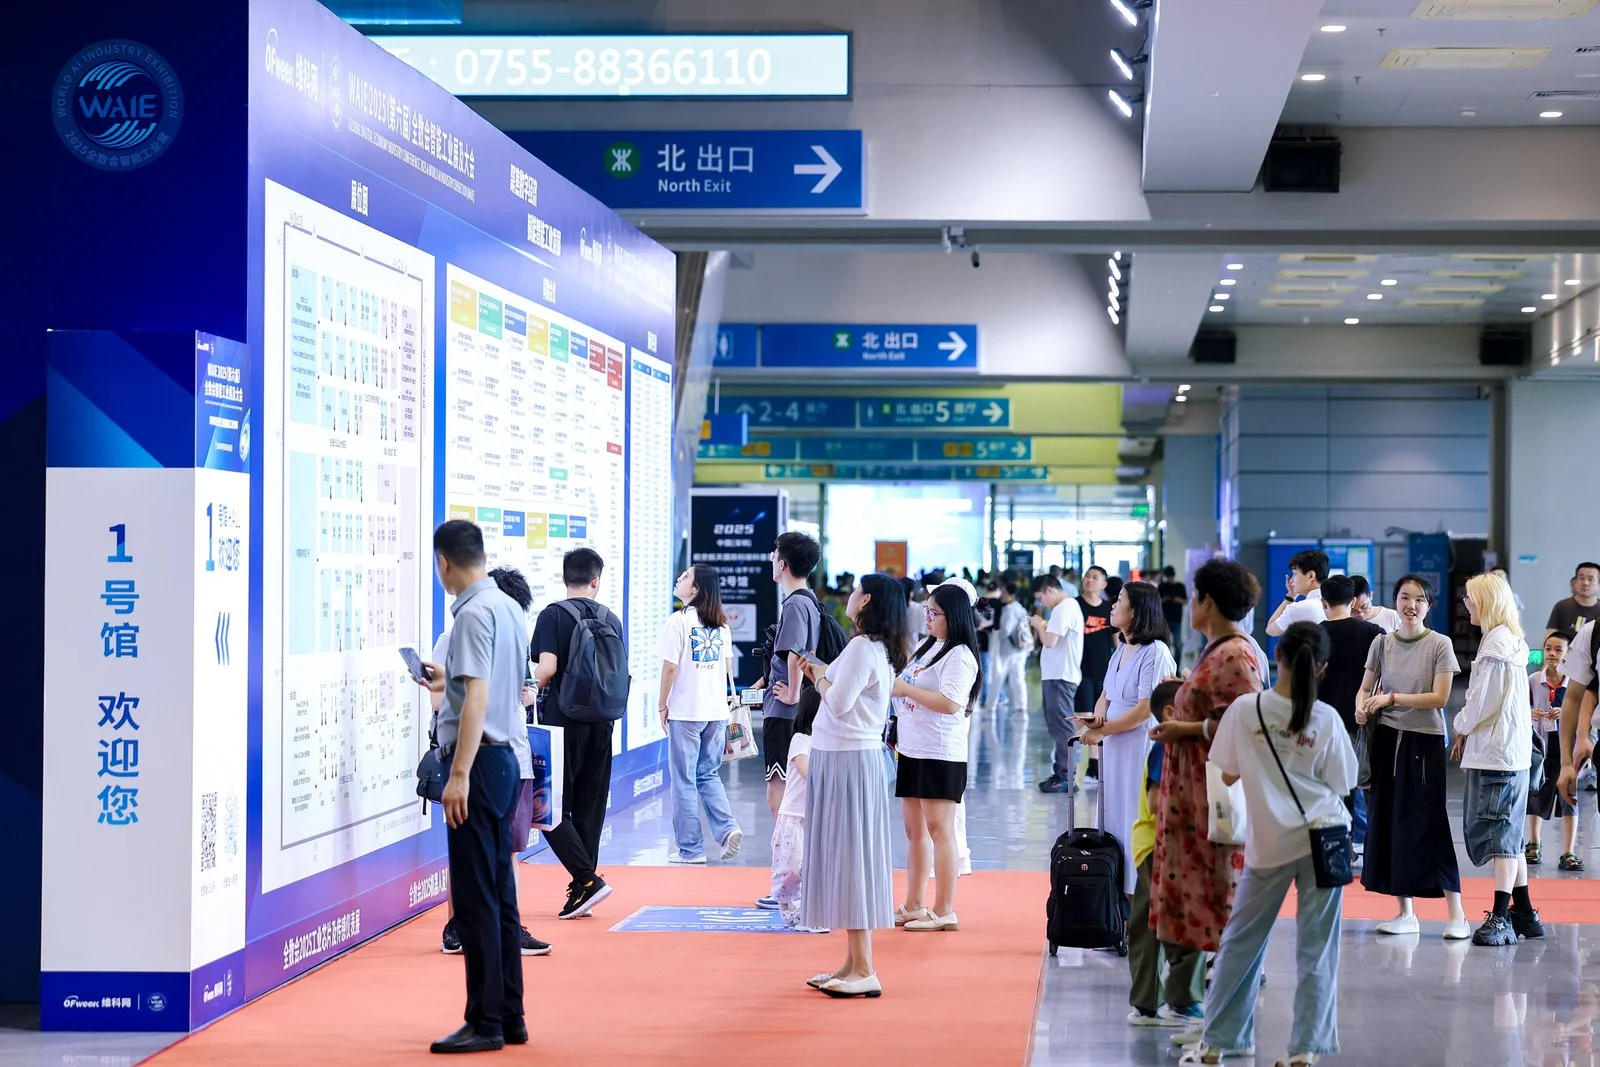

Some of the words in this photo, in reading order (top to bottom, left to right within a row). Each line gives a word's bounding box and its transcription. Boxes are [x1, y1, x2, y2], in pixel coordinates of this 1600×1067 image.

[455, 48, 772, 85] 0755-88366110
[57, 75, 72, 118] WORLD
[71, 62, 82, 75] AI
[82, 44, 144, 63] INDUSTRY
[145, 53, 179, 118] EXHIBITION
[79, 94, 158, 118] WAIE
[348, 71, 368, 113] WAIE
[369, 85, 386, 124] 2025
[65, 130, 170, 167] 2025全数会智能工业展
[657, 144, 686, 172] 北
[697, 144, 753, 172] 出口
[658, 179, 700, 192] North
[704, 179, 731, 192] Exit
[862, 332, 880, 349] 北
[884, 331, 918, 349] 出口
[862, 352, 887, 361] North
[889, 351, 905, 360] Exit
[758, 401, 800, 423] 2-4
[934, 401, 950, 423] 5
[977, 441, 988, 458] 5
[713, 523, 755, 535] 2025
[100, 523, 140, 658] 1号馆
[97, 692, 140, 826] 欢迎您
[101, 997, 131, 1009] 维科网
